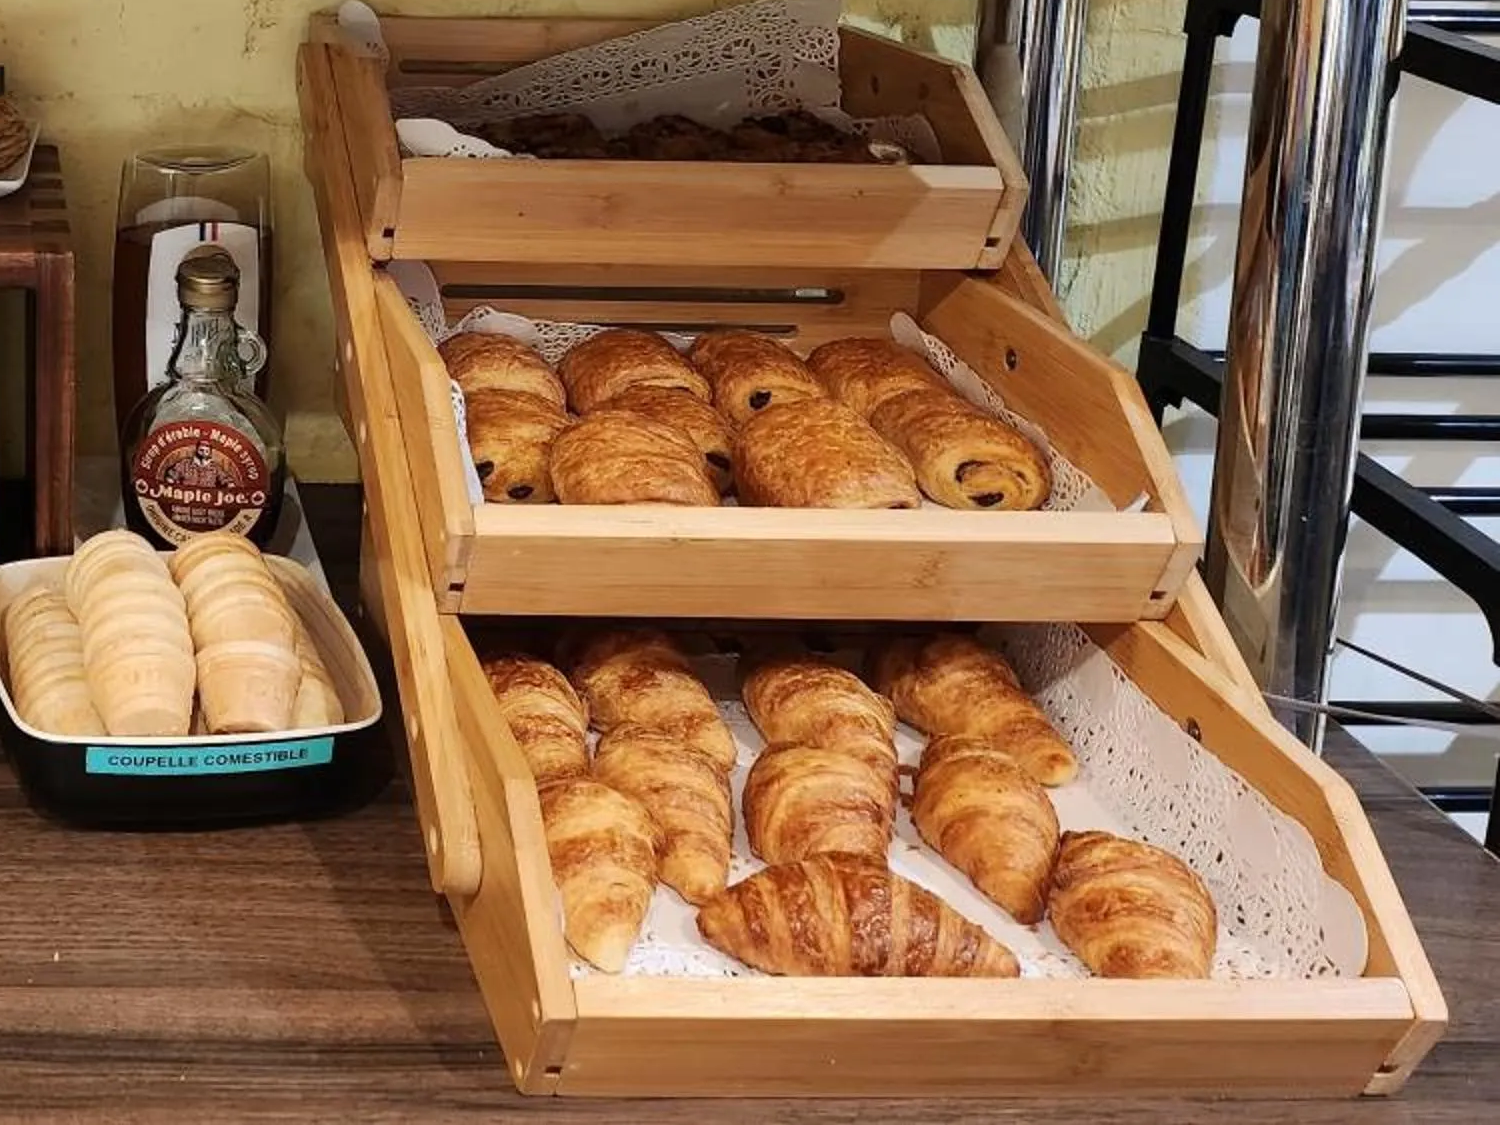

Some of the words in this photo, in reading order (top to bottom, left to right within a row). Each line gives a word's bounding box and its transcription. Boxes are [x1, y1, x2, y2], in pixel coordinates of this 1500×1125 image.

[210, 428, 243, 453] Maple
[148, 484, 213, 504] Maple
[107, 754, 198, 768] COUPELLE
[203, 747, 308, 766] COMESTIBLE
